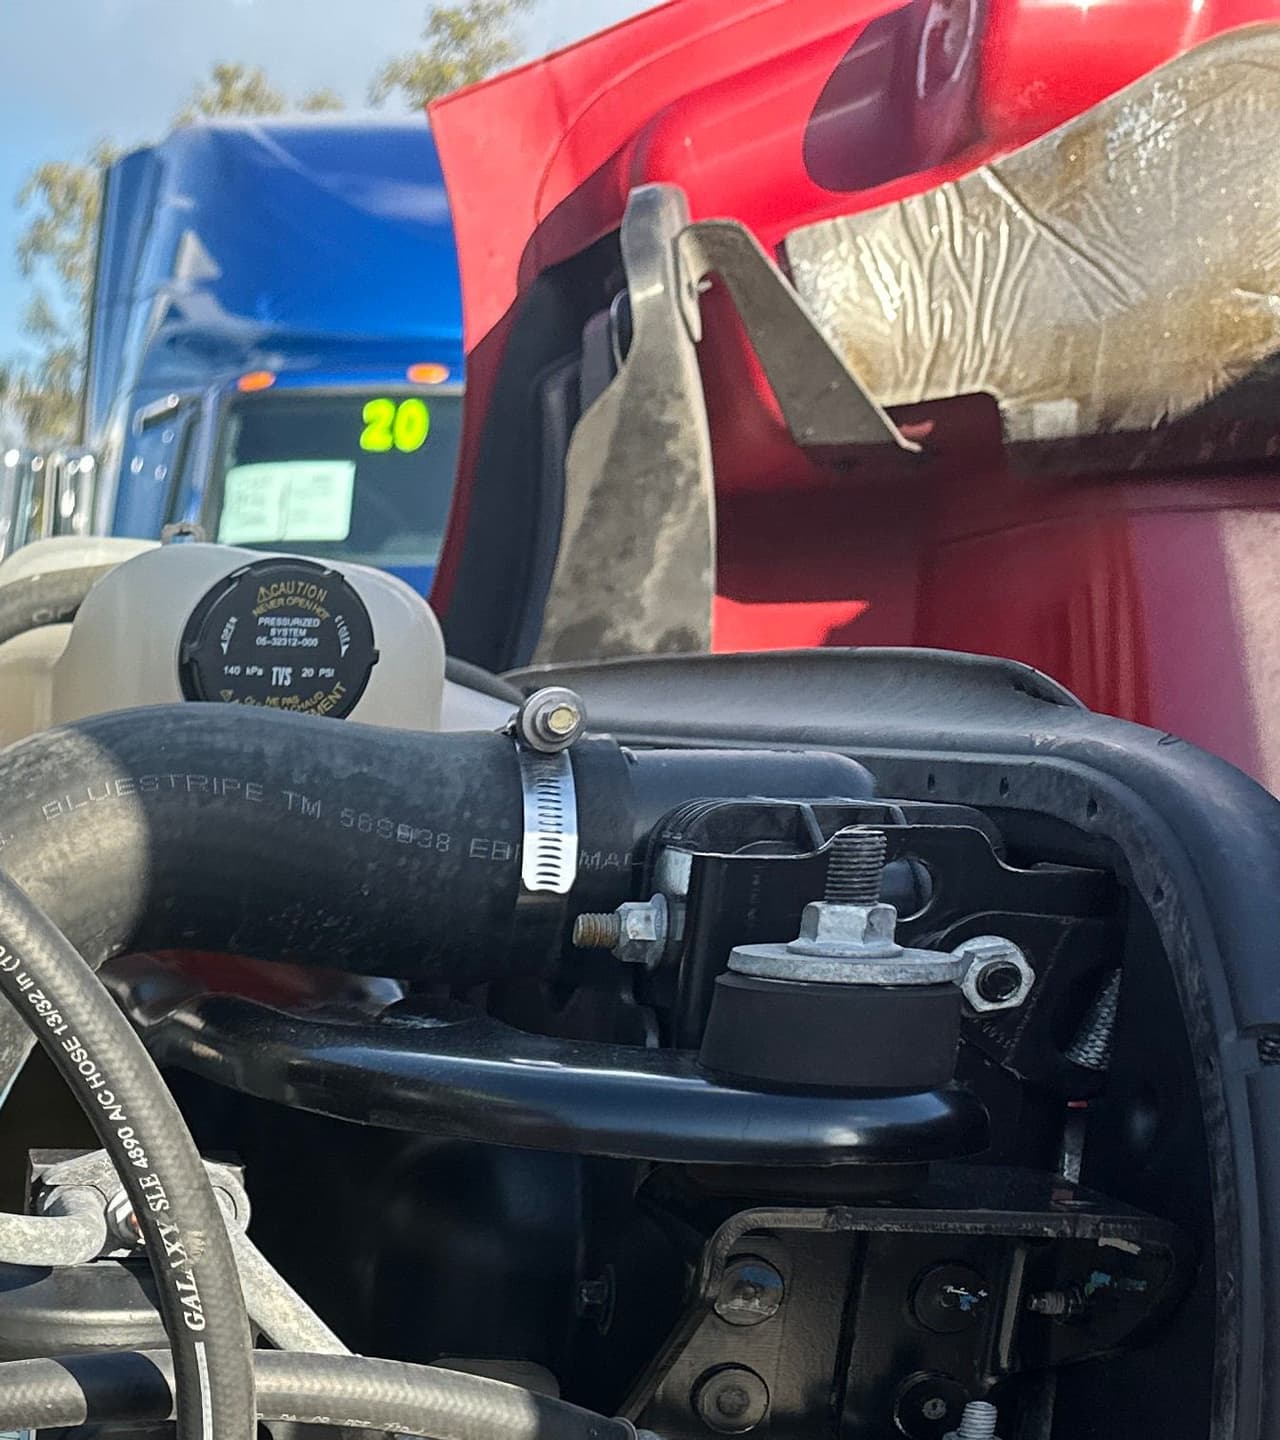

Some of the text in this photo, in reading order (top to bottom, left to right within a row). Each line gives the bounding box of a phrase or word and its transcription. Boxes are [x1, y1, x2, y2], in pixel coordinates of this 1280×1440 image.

[359, 397, 430, 453] 20
[270, 580, 328, 604] CAUTION
[252, 596, 332, 621] NEVER OPEN HOT
[257, 616, 321, 629] PRESSURIZED
[269, 627, 307, 638] SYSTEM
[223, 665, 264, 677] 140 kPa
[271, 666, 294, 687] TVS
[301, 667, 336, 678] 20 PSI
[41, 772, 265, 823] BLUESTRIPE
[281, 789, 322, 819] TM
[15, 972, 35, 992] in
[27, 989, 69, 1036] 13/32
[61, 1035, 107, 1089] HOSE
[96, 1090, 128, 1122] A/C
[117, 1126, 149, 1169] 4890
[139, 1173, 170, 1213] SLE
